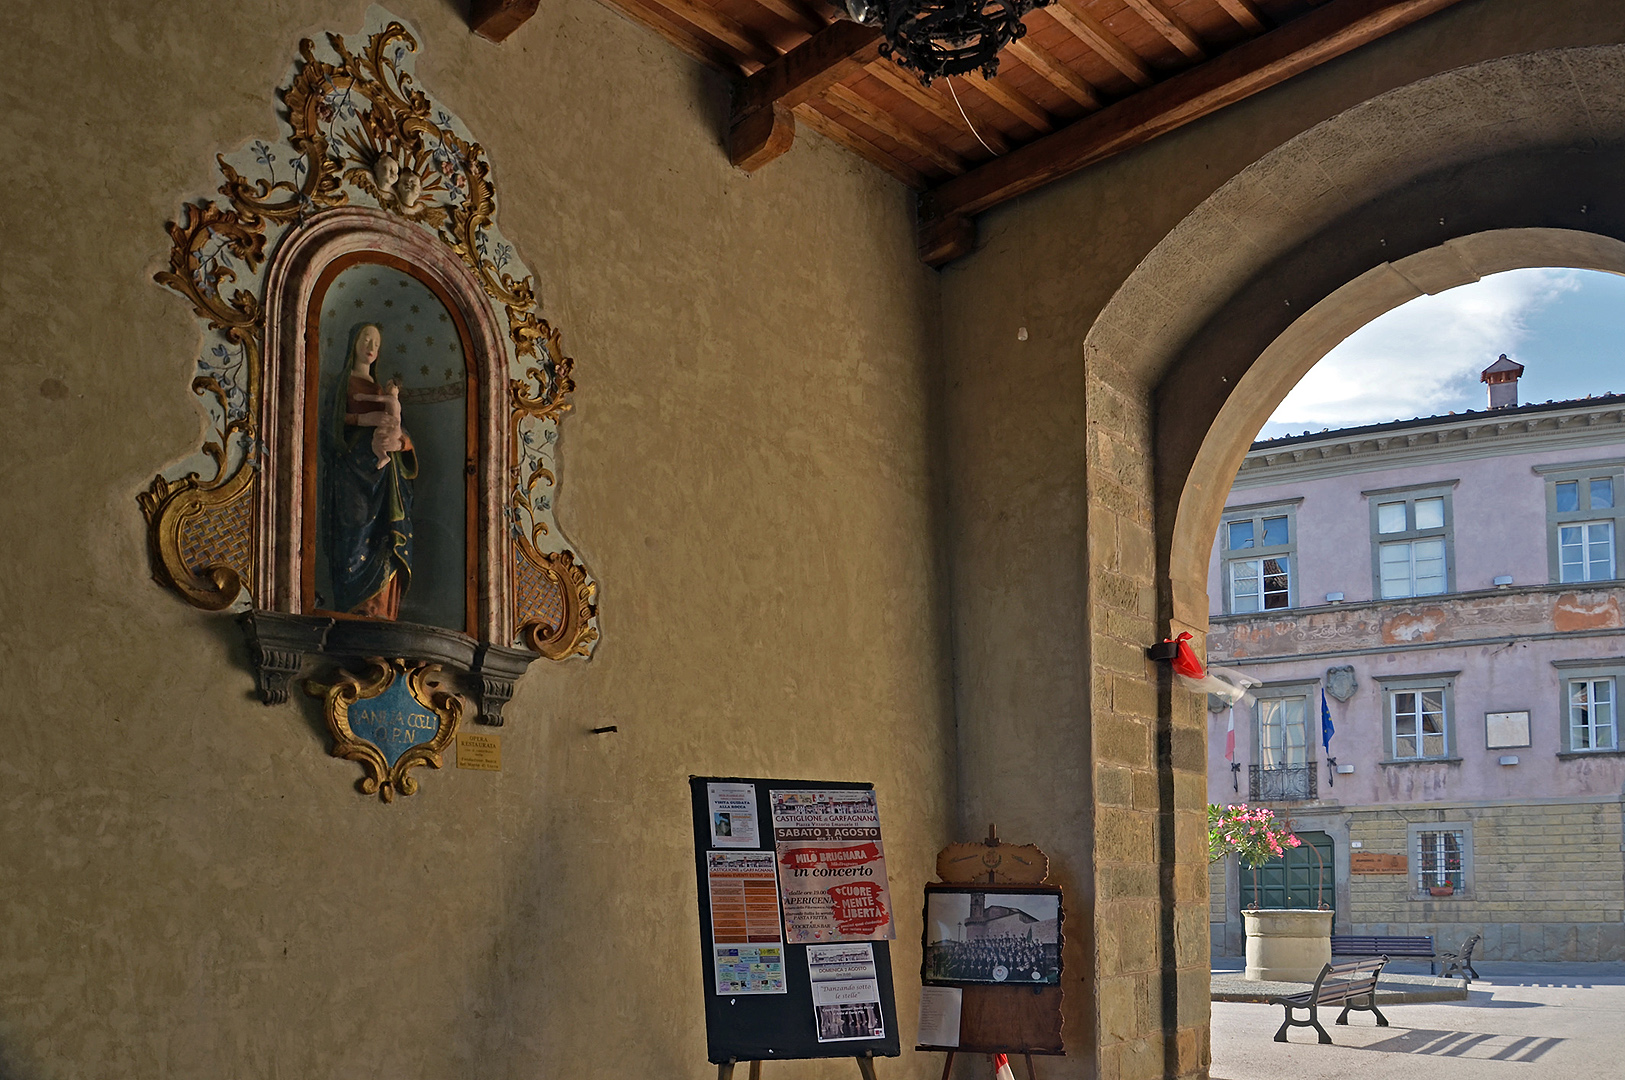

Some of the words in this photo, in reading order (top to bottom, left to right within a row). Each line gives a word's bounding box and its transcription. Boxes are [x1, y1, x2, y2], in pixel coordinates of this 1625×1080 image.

[469, 735, 488, 743] OPERA
[461, 741, 497, 749] RESTAURATA
[775, 814, 823, 822] CASTIGLIONE
[828, 814, 878, 822] GARFAGNANA
[778, 828, 822, 837] SABATO
[825, 828, 831, 837] 1
[834, 828, 878, 837] AGOSTO
[819, 850, 867, 862] BRUGNARA
[794, 865, 809, 877] in
[812, 865, 873, 878] concerto
[842, 886, 872, 896] CUORE
[784, 896, 835, 905] APERICENA
[842, 896, 875, 908] MENTE
